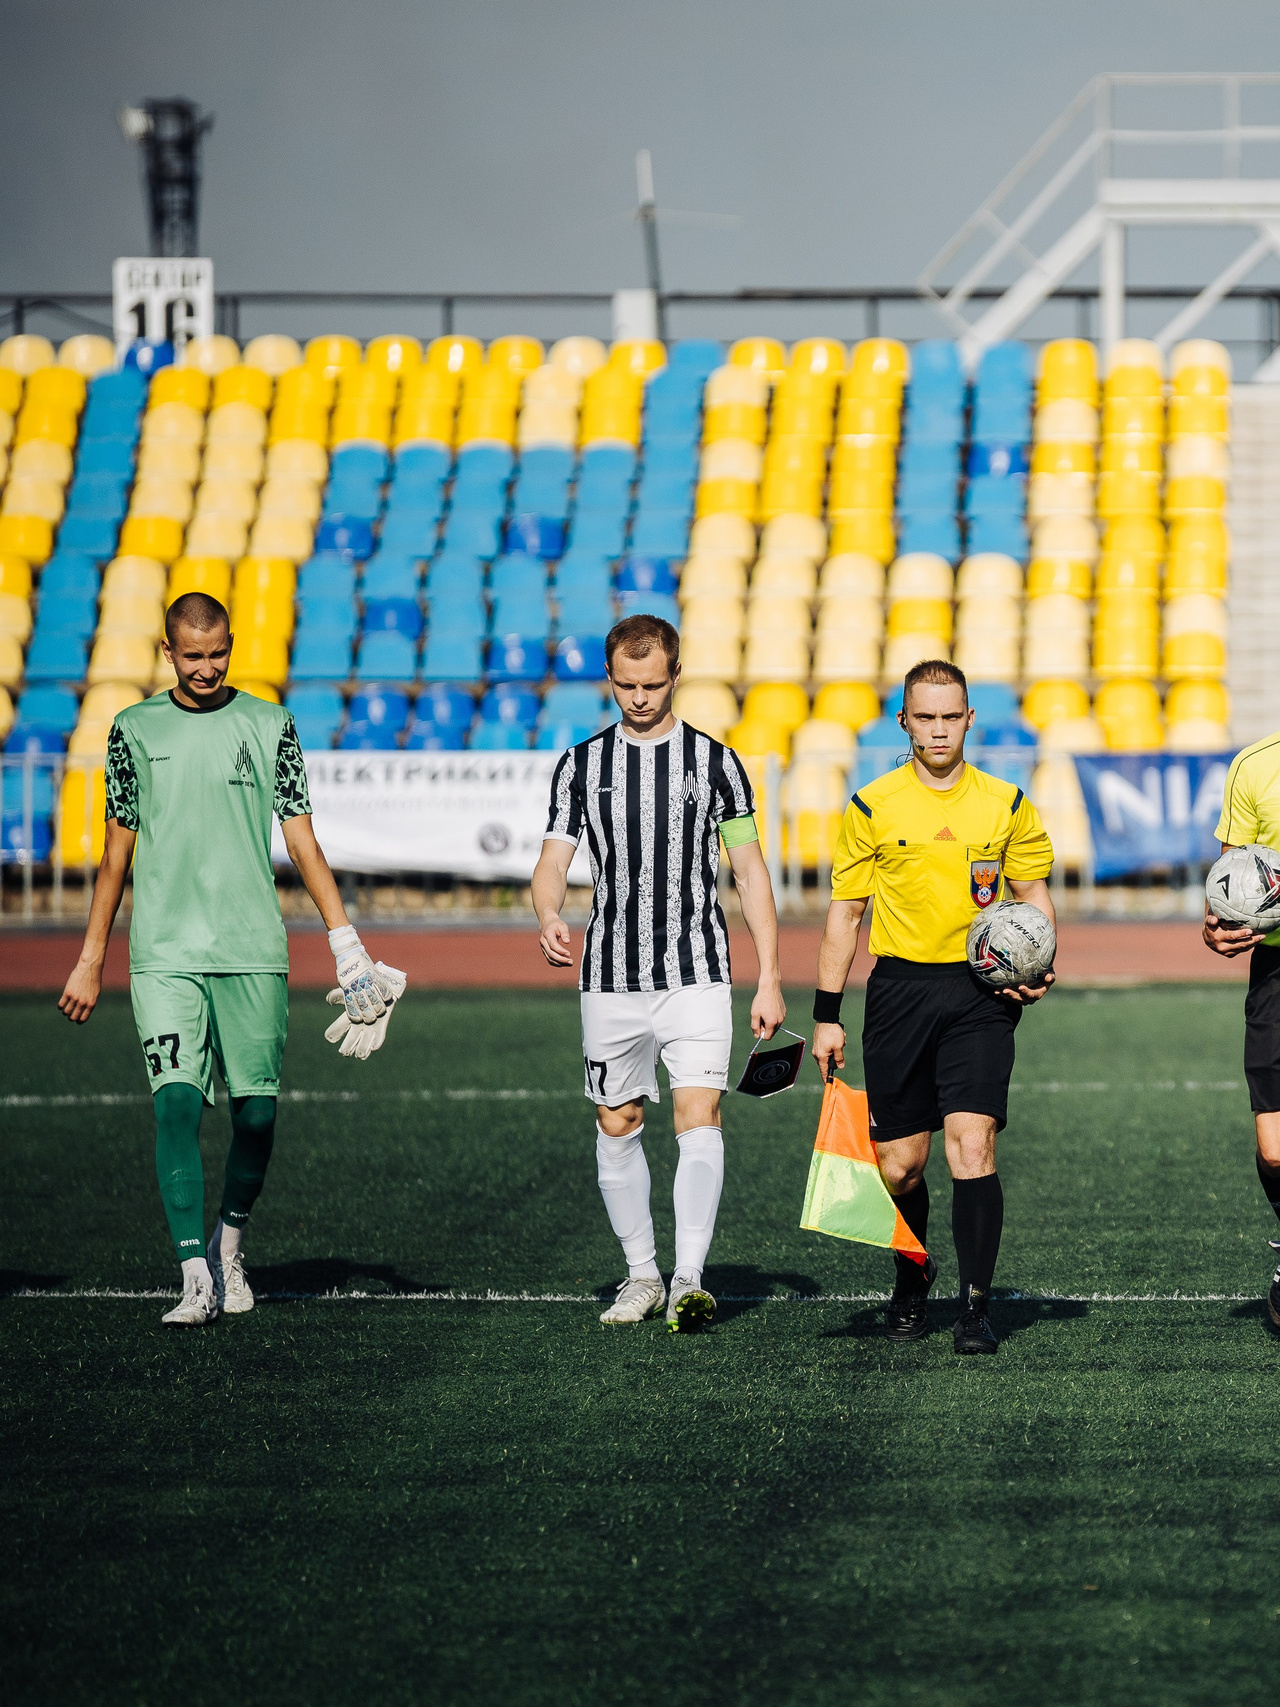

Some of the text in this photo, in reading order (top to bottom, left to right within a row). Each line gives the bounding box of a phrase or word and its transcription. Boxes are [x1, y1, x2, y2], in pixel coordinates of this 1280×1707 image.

[129, 298, 194, 342] 16
[306, 755, 553, 784] ЛЕКТРИКИ7
[1007, 919, 1041, 949] DEMIX
[143, 1033, 180, 1077] 57
[585, 1056, 607, 1097] 17
